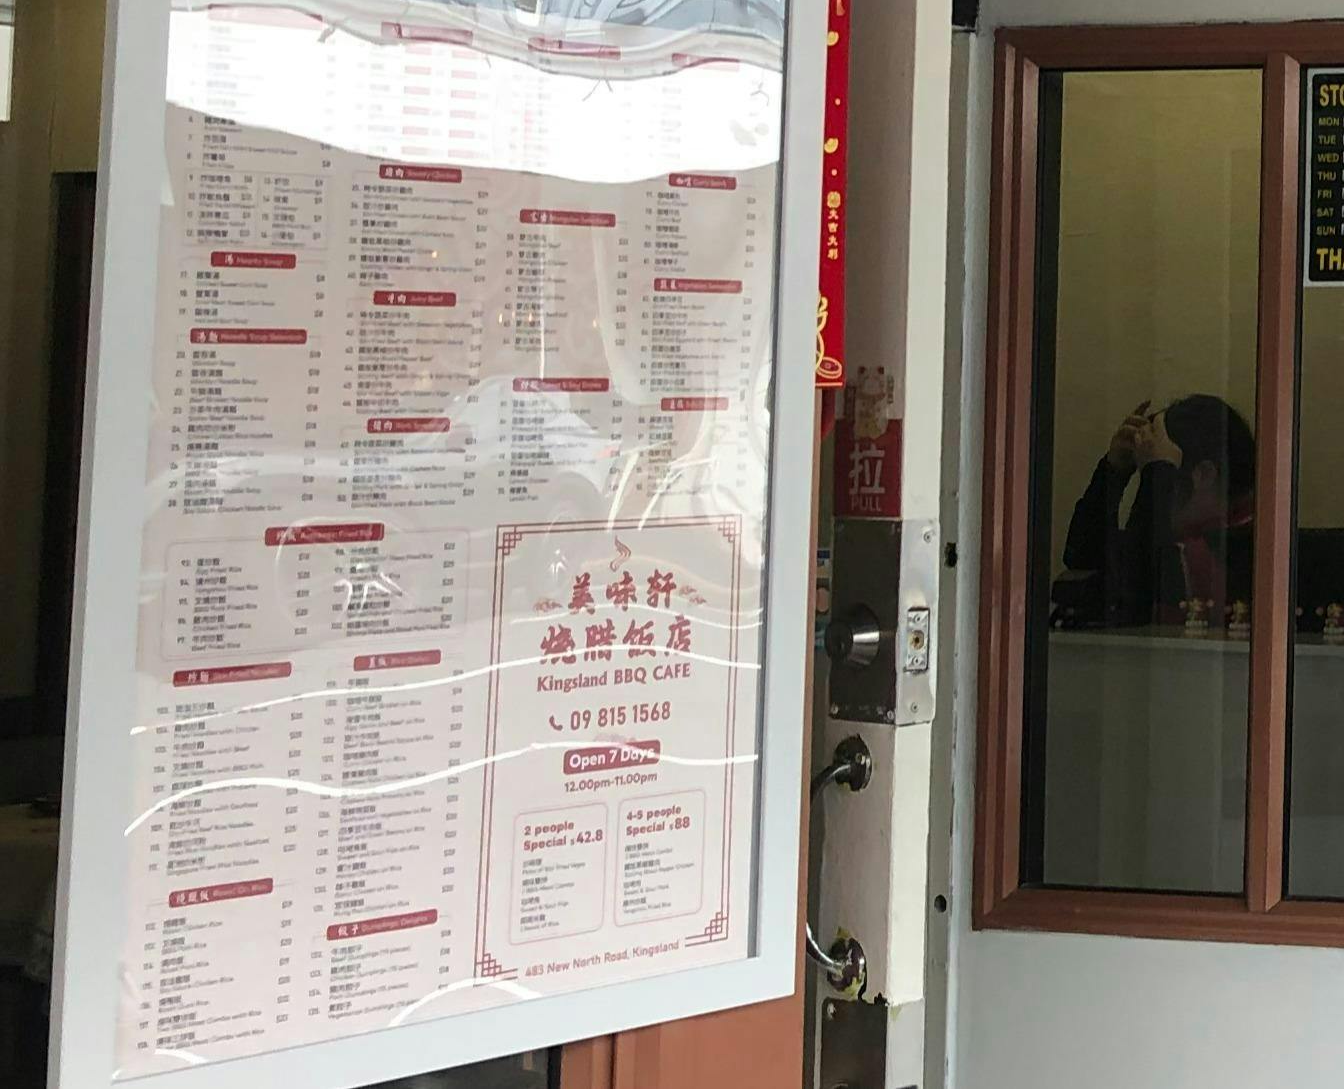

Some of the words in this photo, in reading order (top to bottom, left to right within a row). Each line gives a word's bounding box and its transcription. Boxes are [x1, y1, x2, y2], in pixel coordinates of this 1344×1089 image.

[1318, 117, 1341, 126] MON
[1318, 135, 1337, 144] TUE
[1317, 153, 1340, 161] WED
[1317, 171, 1337, 180] THU
[1317, 189, 1332, 198] FRI
[1316, 207, 1334, 217] SAT
[1316, 226, 1336, 235] SUN
[849, 442, 885, 494] 拉
[851, 496, 881, 511] PULL
[568, 570, 677, 615] 美味轩
[540, 614, 692, 664] 烧腊饭店
[537, 671, 608, 693] Kingsland
[614, 667, 647, 685] BBQ
[652, 663, 691, 680] CAFE
[570, 709, 592, 731] 09
[598, 706, 626, 728] 815
[632, 701, 671, 724] 1568
[569, 753, 606, 771] Open
[609, 749, 618, 763] 7
[620, 746, 656, 764] Days
[564, 772, 658, 793] 12.00pm-11.00pm
[646, 805, 682, 821] people
[524, 825, 531, 836] 2
[535, 821, 575, 838] people
[626, 821, 665, 837] Special
[523, 835, 567, 852] Special
[547, 961, 569, 974] New
[573, 956, 601, 969] North
[632, 940, 680, 959] Kingsland
